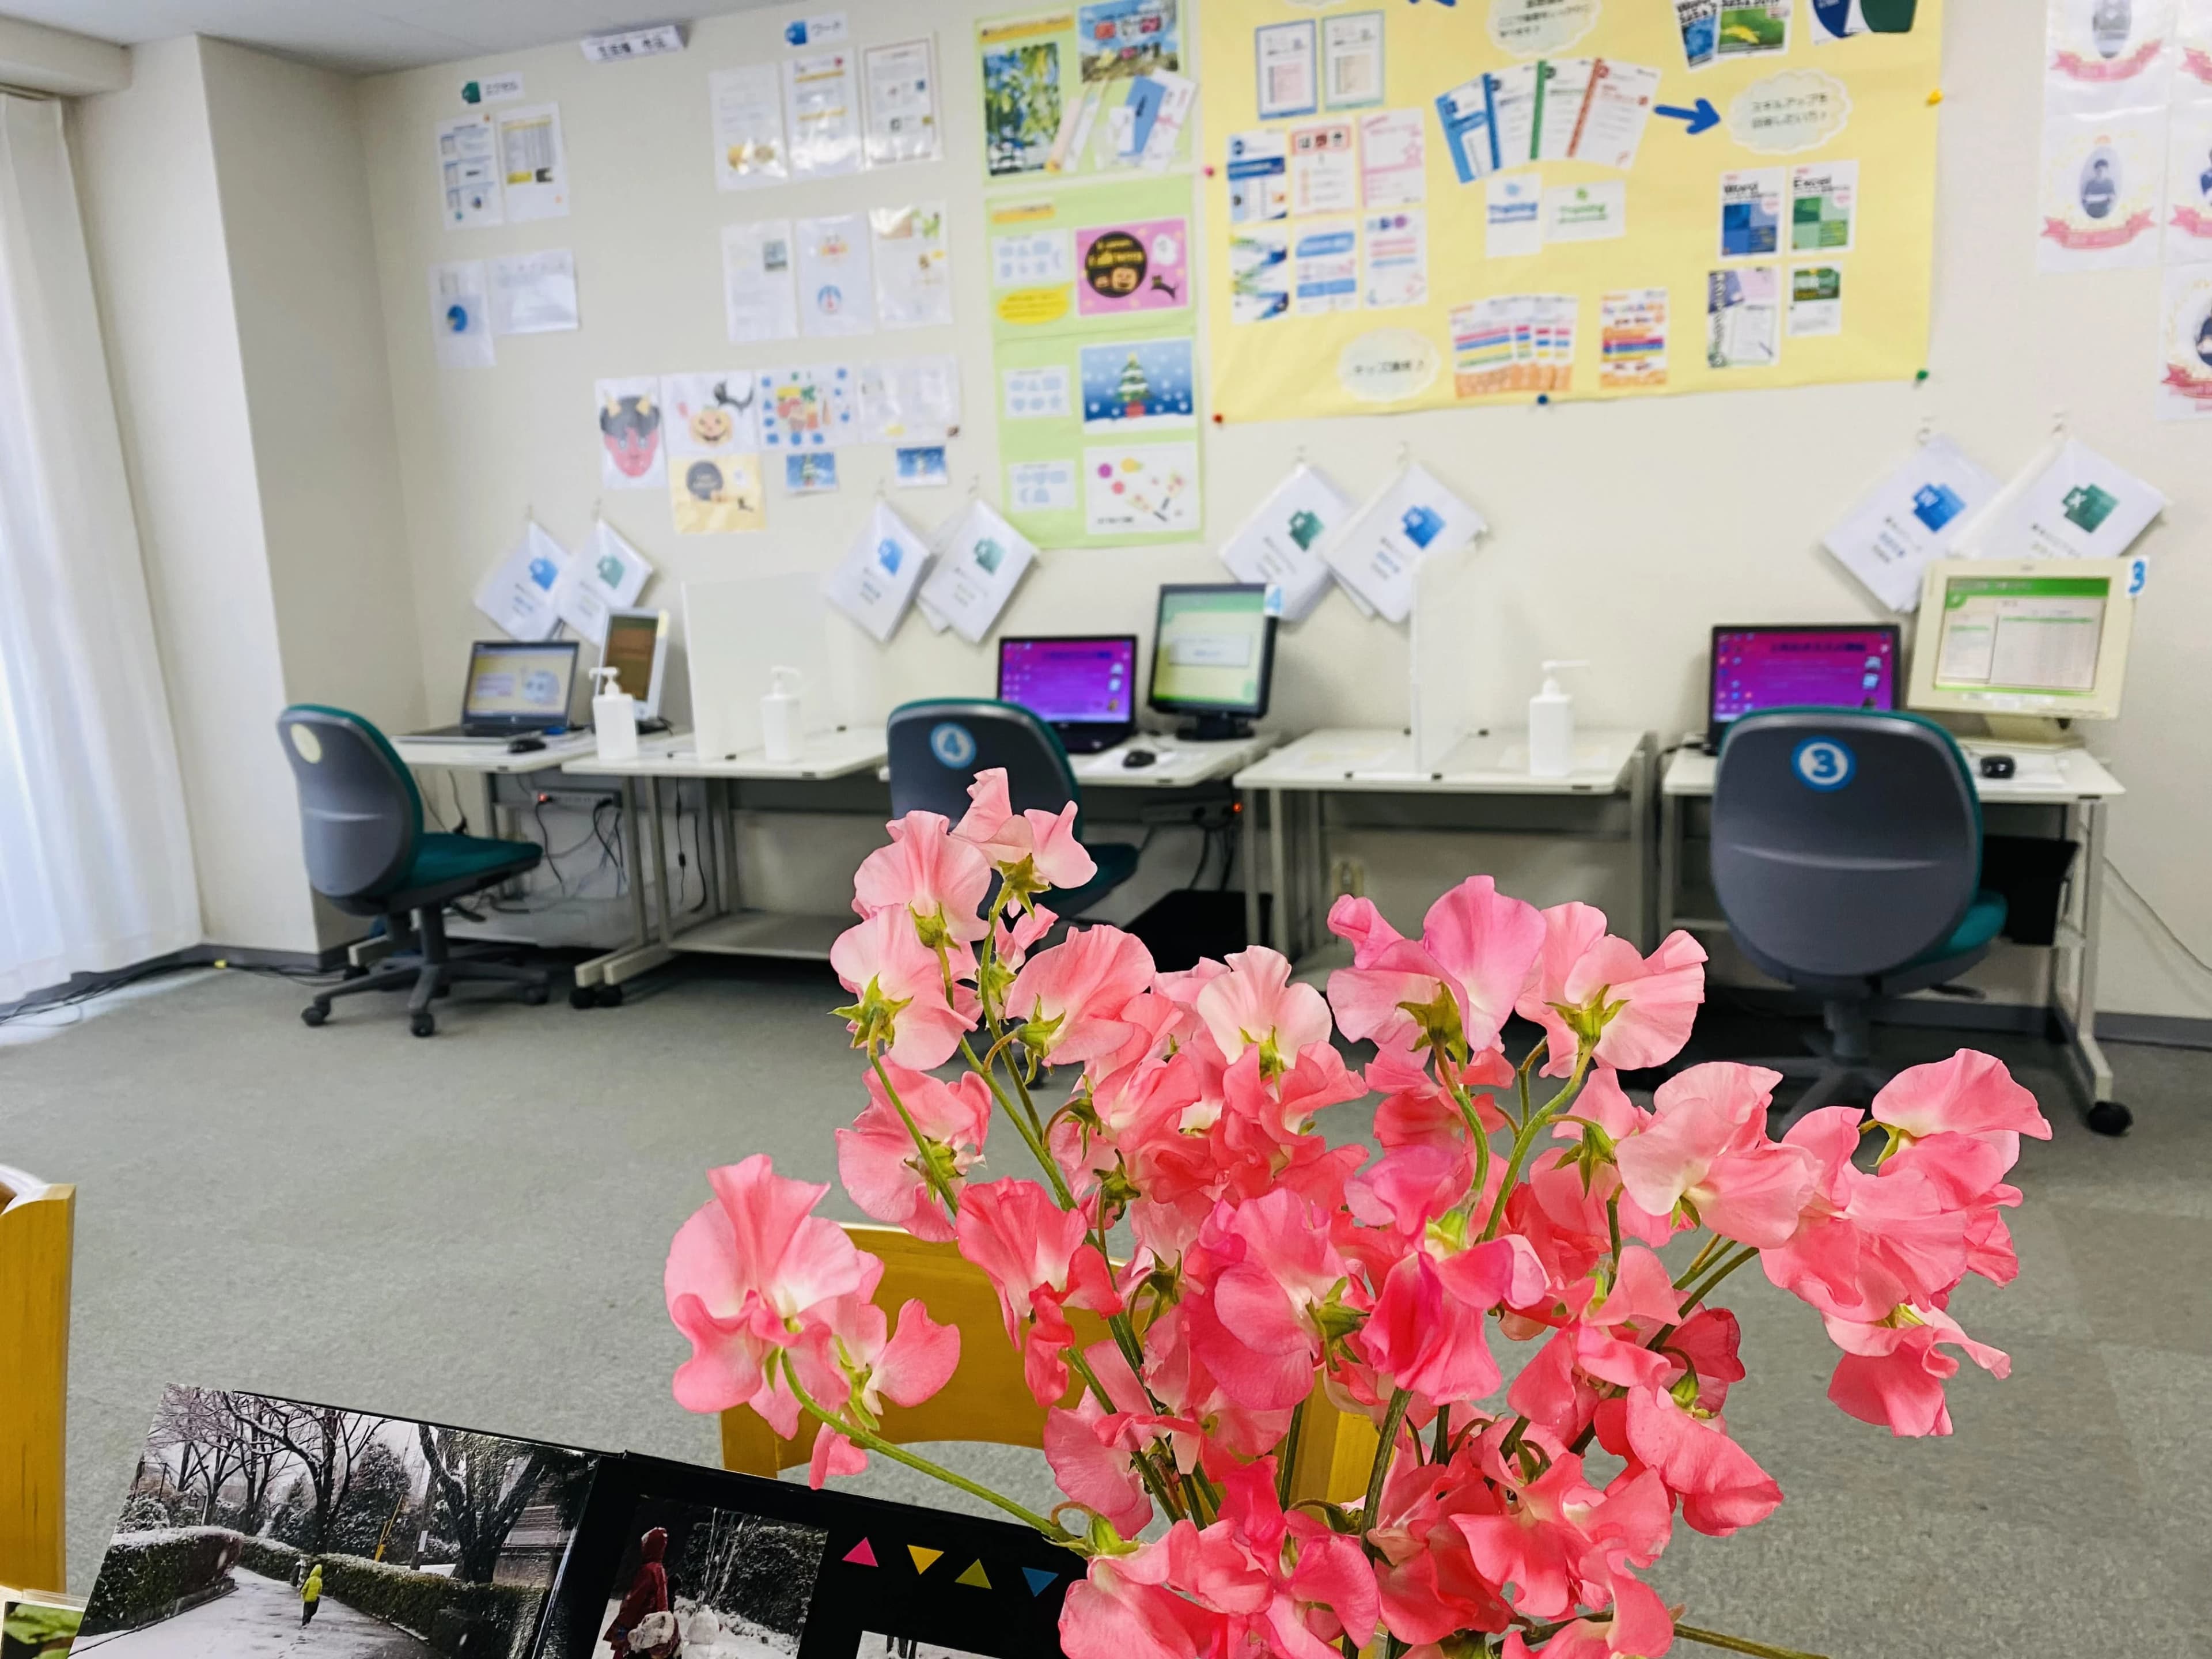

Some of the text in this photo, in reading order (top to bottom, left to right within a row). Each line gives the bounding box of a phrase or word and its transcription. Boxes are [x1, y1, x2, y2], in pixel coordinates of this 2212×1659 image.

[2128, 560, 2145, 594] 3
[942, 731, 961, 757] 4
[1812, 749, 1838, 778] 3
